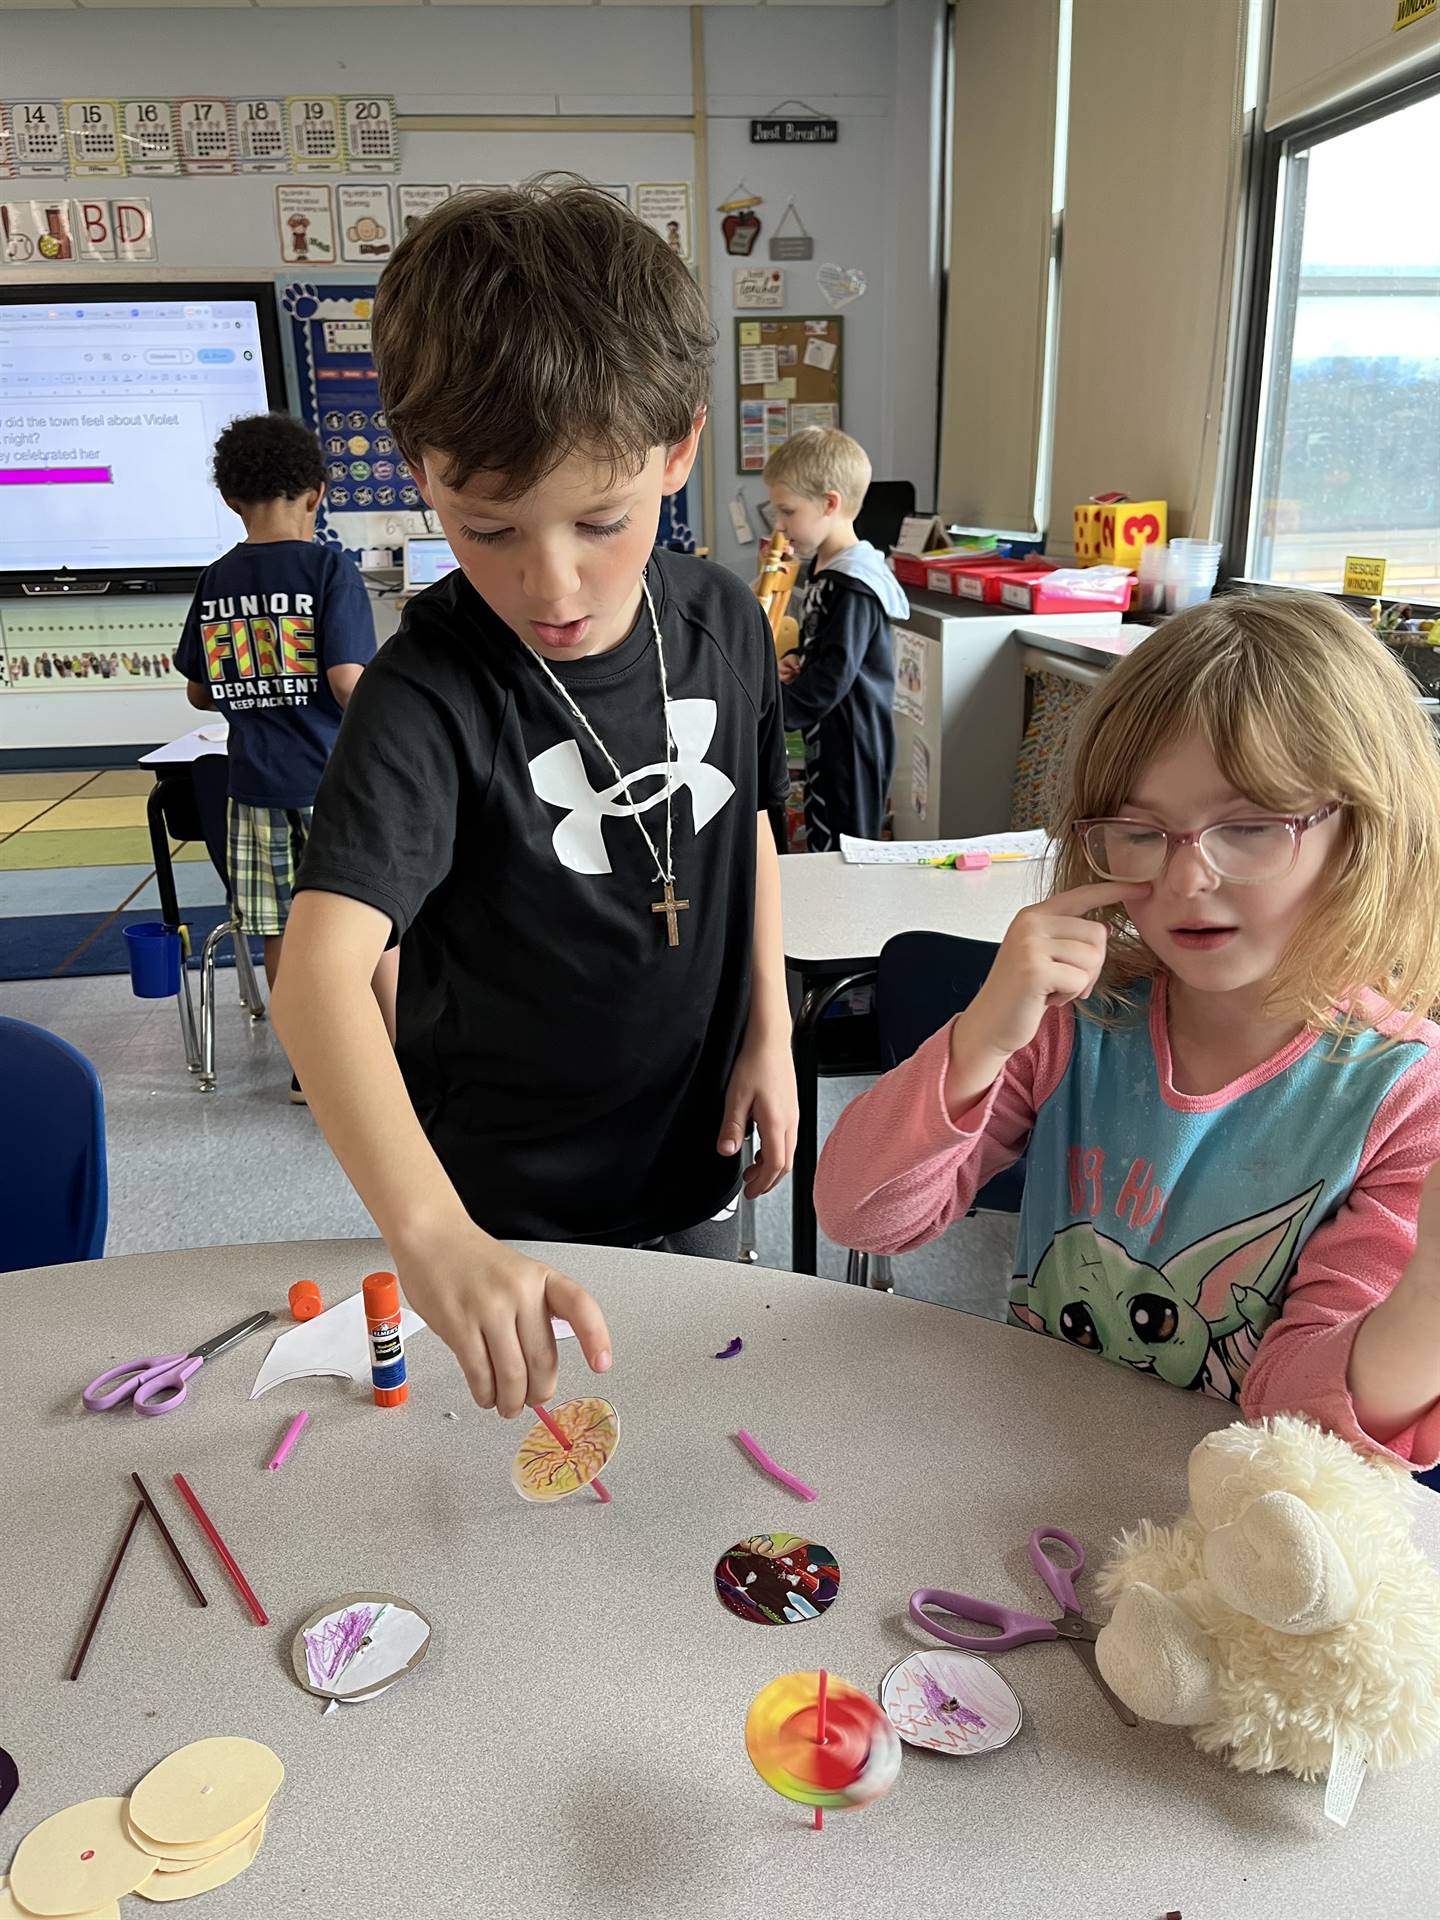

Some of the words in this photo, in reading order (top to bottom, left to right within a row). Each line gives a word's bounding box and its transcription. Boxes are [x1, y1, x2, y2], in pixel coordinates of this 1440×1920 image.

[1398, 0, 1435, 21] WIND
[24, 105, 46, 123] 14
[83, 105, 102, 123] 15
[138, 104, 158, 121] 16
[194, 104, 213, 120] 17
[248, 103, 268, 120] 18
[304, 103, 323, 119] 19
[355, 102, 381, 120] 20
[754, 123, 781, 141] Just
[785, 123, 836, 141] Breathe
[83, 204, 107, 243] B
[117, 205, 146, 243] D
[5, 416, 24, 428] did
[27, 416, 46, 428] the
[49, 416, 79, 427] town
[82, 415, 104, 427] feel
[107, 414, 141, 426] about
[143, 414, 179, 426] Violet
[3, 432, 41, 447] night?
[13, 449, 77, 462] celebrated
[79, 448, 100, 460] her
[1348, 562, 1381, 577] RESCUE
[1347, 576, 1379, 592] WINDOW
[200, 593, 313, 620] JUNIOR
[200, 616, 319, 682] FIRE
[211, 678, 319, 700] DEPARTENT
[229, 699, 255, 711] KEEP
[295, 696, 308, 706] FT
